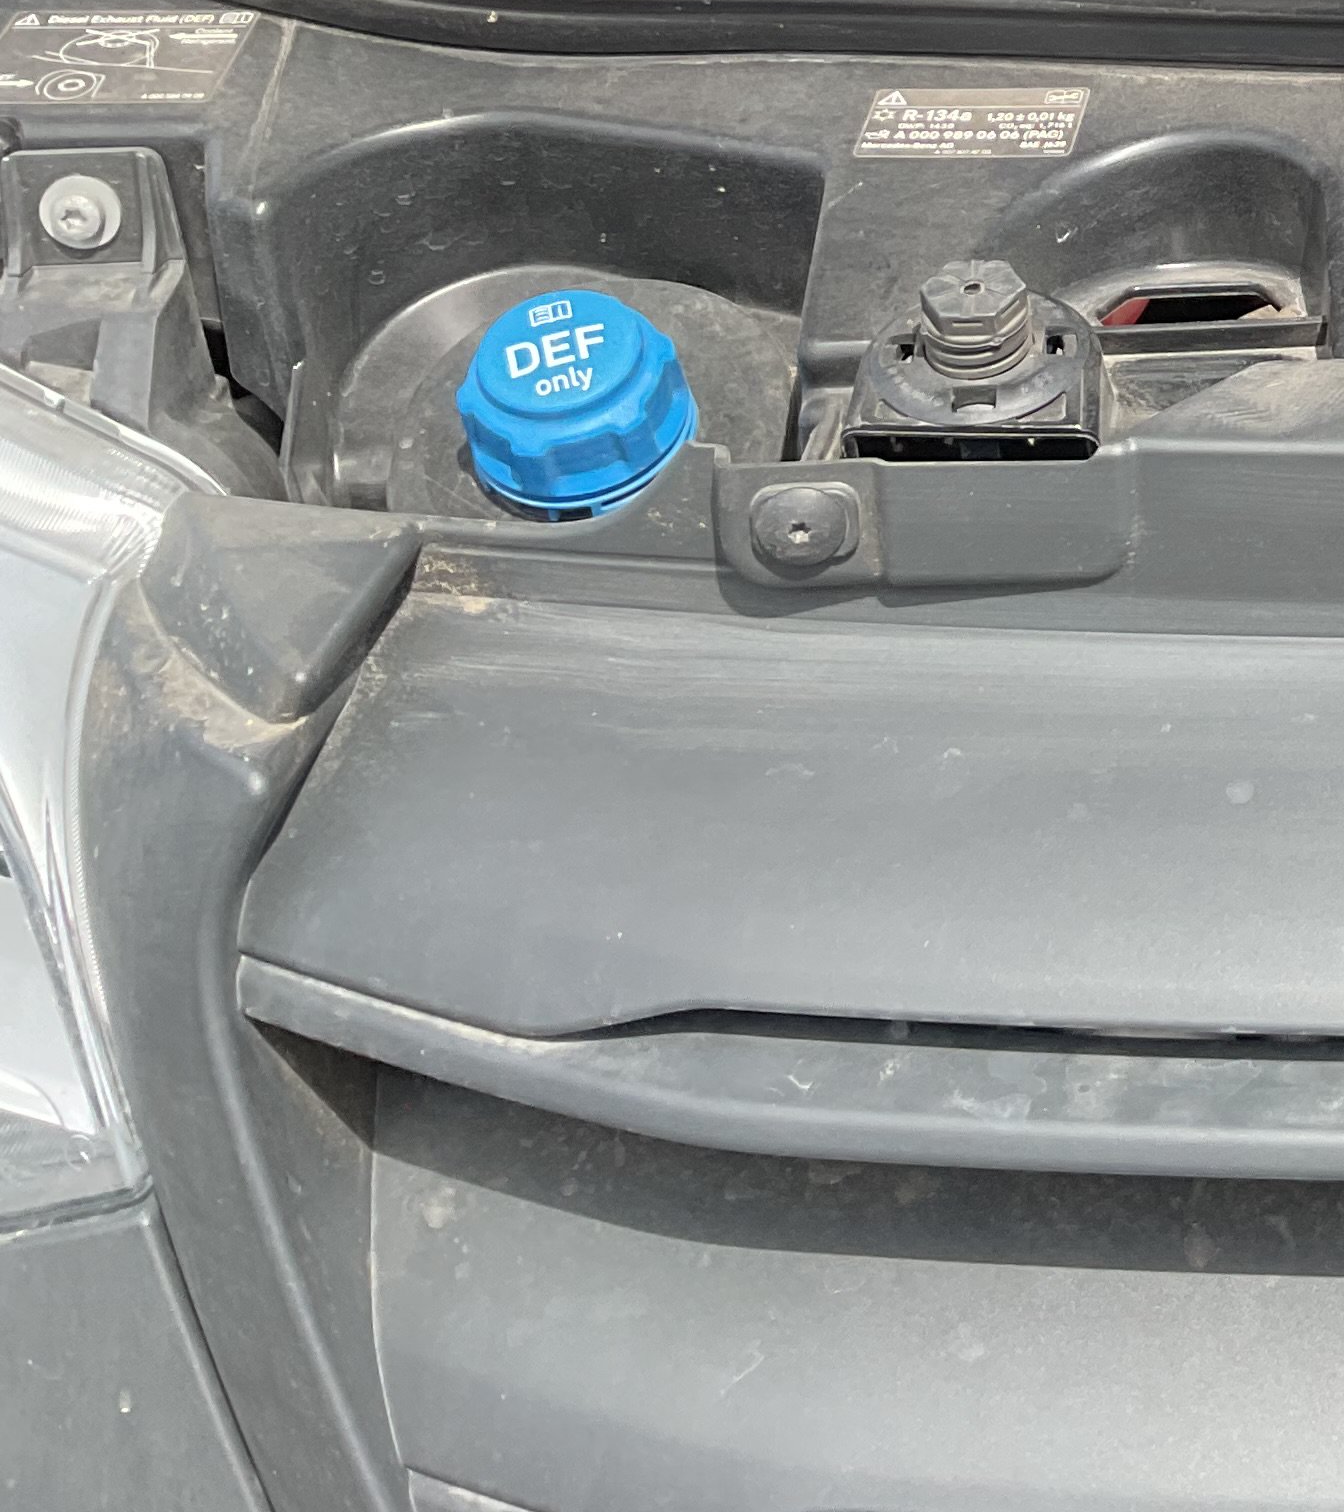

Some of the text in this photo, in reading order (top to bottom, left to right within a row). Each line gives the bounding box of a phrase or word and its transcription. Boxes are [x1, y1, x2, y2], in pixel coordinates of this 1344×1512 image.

[47, 14, 215, 24] Diesel Exhaust Fluid (DEF)
[902, 109, 972, 122] R-134a
[987, 112, 1014, 123] 1,20
[1027, 112, 1055, 123] 0,01
[1057, 111, 1075, 122] kg
[893, 129, 1064, 140] A 000 989 06 06 (PAG)
[861, 141, 938, 149] Mercedes-Benz
[505, 323, 605, 380] DEF
[535, 366, 593, 396] only
